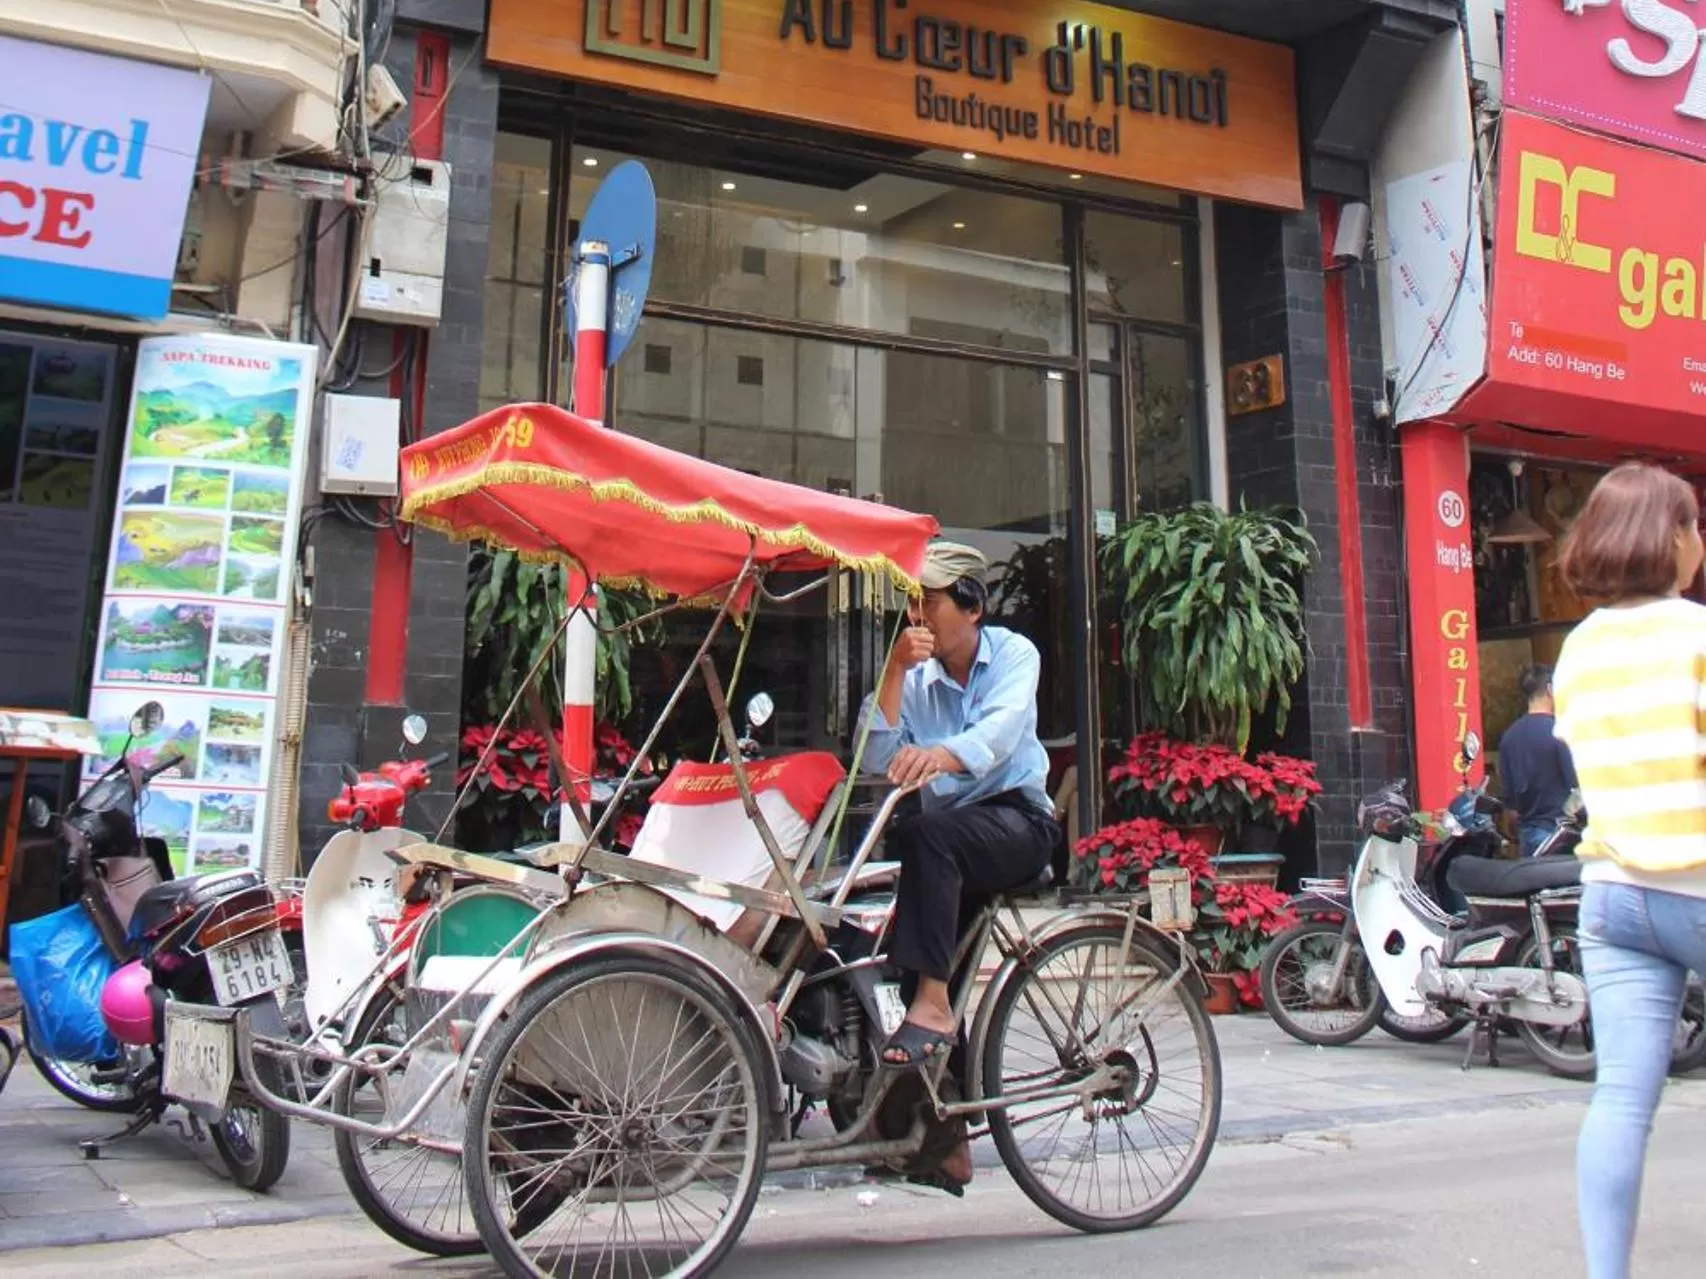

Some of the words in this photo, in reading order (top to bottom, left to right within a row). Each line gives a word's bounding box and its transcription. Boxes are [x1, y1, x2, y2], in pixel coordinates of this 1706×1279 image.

[915, 74, 1038, 142] Boutique
[1047, 102, 1121, 155] Hotel
[1544, 352, 1562, 369] 60
[1566, 355, 1603, 380] Hang
[1605, 363, 1626, 381] Be
[1442, 497, 1461, 520] 60
[1435, 538, 1460, 575] Hang
